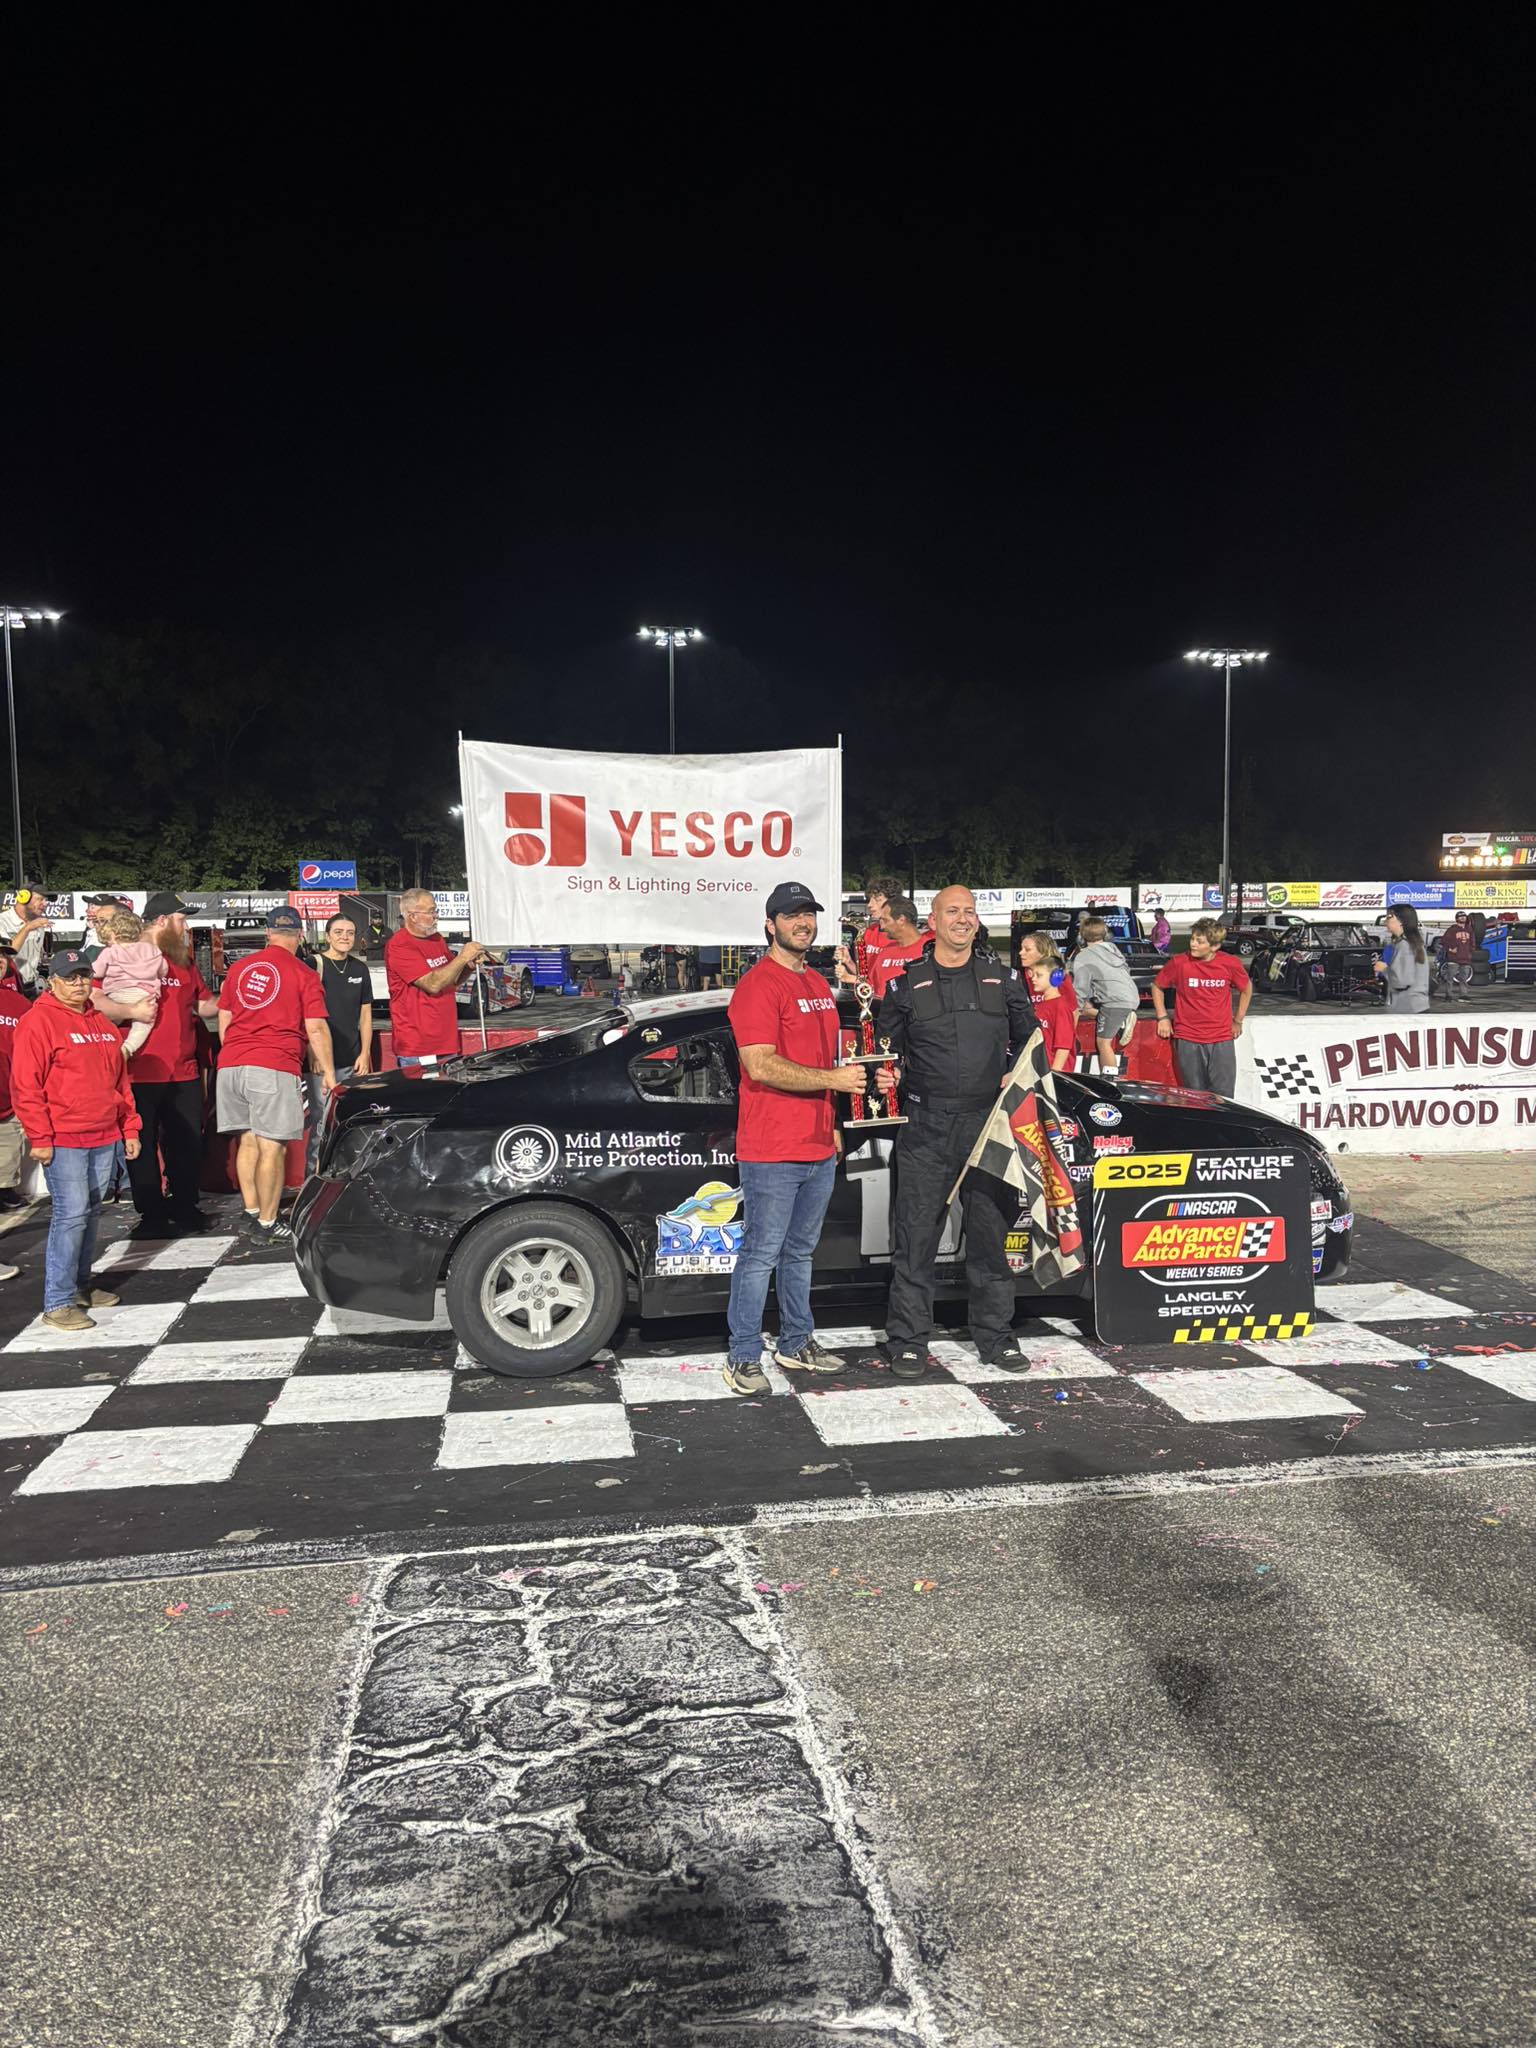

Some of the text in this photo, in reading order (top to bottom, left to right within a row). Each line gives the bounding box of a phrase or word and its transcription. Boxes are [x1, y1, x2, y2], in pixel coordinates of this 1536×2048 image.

[323, 869, 354, 880] pepsi
[567, 876, 603, 892] Sign
[608, 876, 622, 890] &
[627, 877, 690, 894] Lighting
[1457, 888, 1484, 897] LARRY
[1270, 892, 1286, 902] JOE
[1200, 979, 1226, 988] YESCO
[808, 998, 836, 1011] YESCO
[1299, 1099, 1500, 1129] HARDWOOD
[565, 1131, 681, 1149] Mid Atlantic
[1093, 1135, 1133, 1150] Holley
[565, 1151, 603, 1168] Fire
[608, 1150, 708, 1168] Protection,
[1196, 1155, 1295, 1170] FEATURE
[1108, 1164, 1182, 1180] 2025
[1195, 1168, 1282, 1182] WINNER
[1183, 1200, 1238, 1216] NASCAR
[1144, 1222, 1237, 1245] Advance
[1132, 1242, 1233, 1262] Auto Parts
[1166, 1265, 1244, 1279] WEEKLY SERIES
[1165, 1290, 1247, 1304] LANGLEY
[1158, 1303, 1255, 1318] SPEEDWAY
